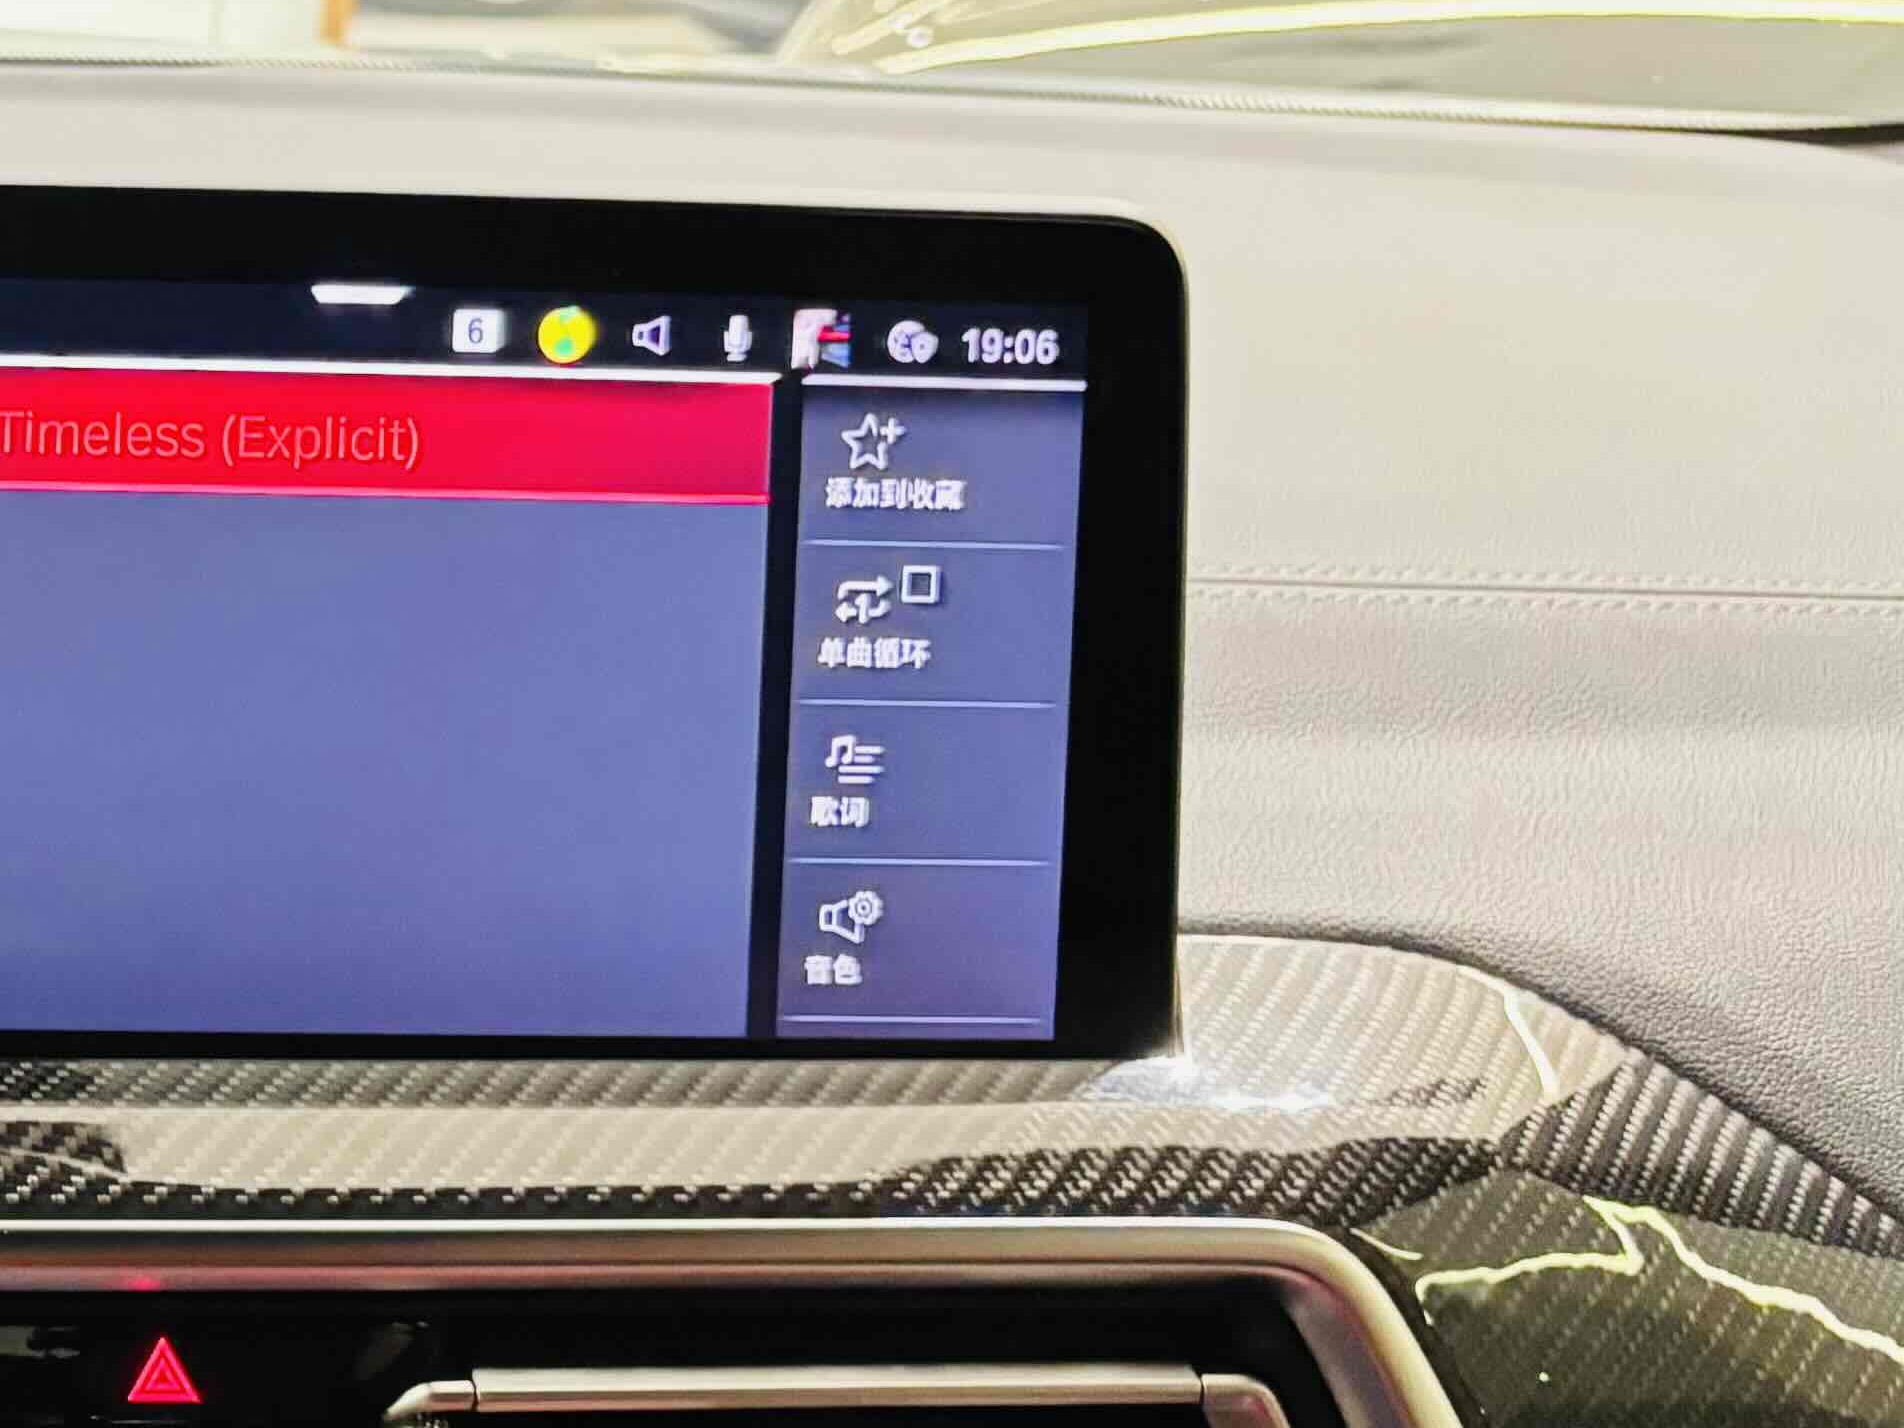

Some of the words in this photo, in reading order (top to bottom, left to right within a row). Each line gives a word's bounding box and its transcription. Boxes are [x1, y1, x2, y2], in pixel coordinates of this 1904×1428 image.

[961, 325, 1060, 366] 19:06
[220, 412, 420, 472] (Explicit)
[824, 476, 965, 512] 添加到收藏
[818, 636, 931, 670] 单曲循环
[809, 795, 870, 828] 歌词
[804, 954, 862, 986] 音色
